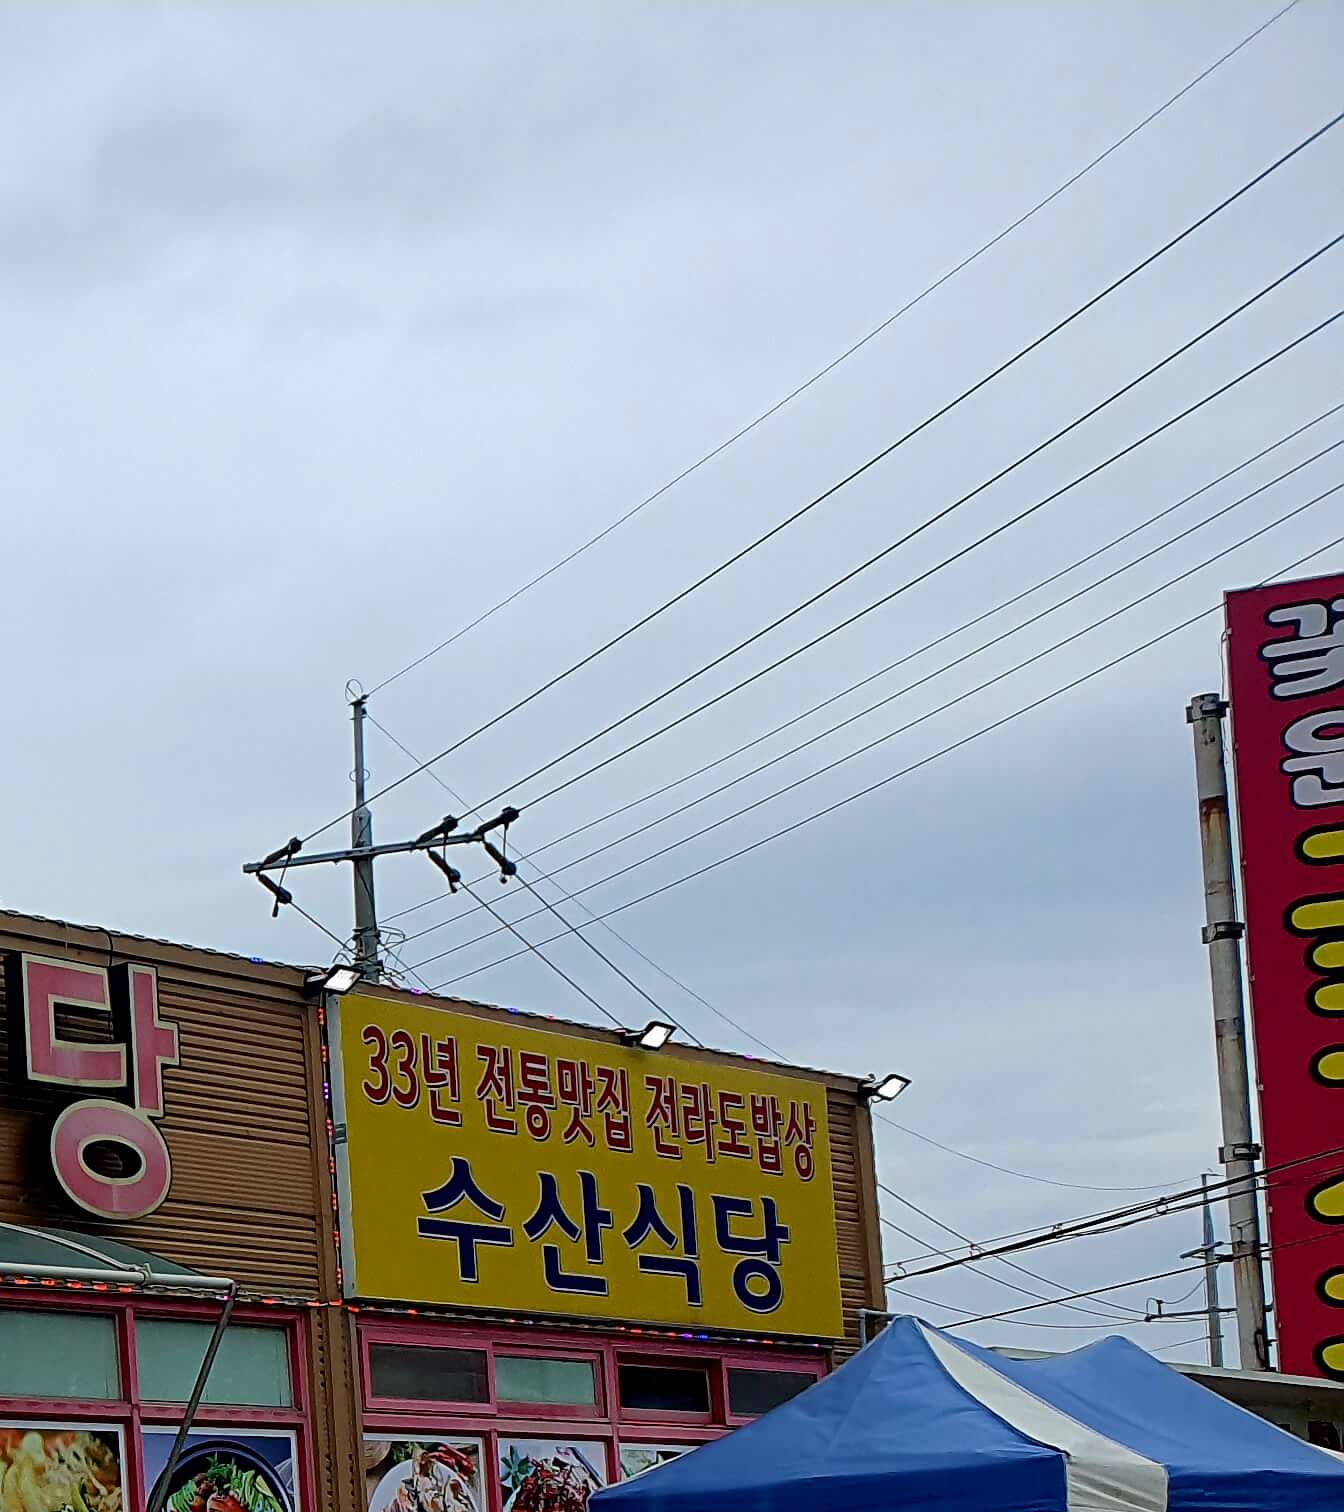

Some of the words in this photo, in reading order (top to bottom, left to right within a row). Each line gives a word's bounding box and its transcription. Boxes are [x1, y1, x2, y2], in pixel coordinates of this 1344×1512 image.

[361, 1024, 462, 1126] 33년
[475, 1042, 634, 1153] 전통맛집
[644, 1074, 816, 1181] 전라도밥상
[416, 1155, 791, 1313] 수산식당
